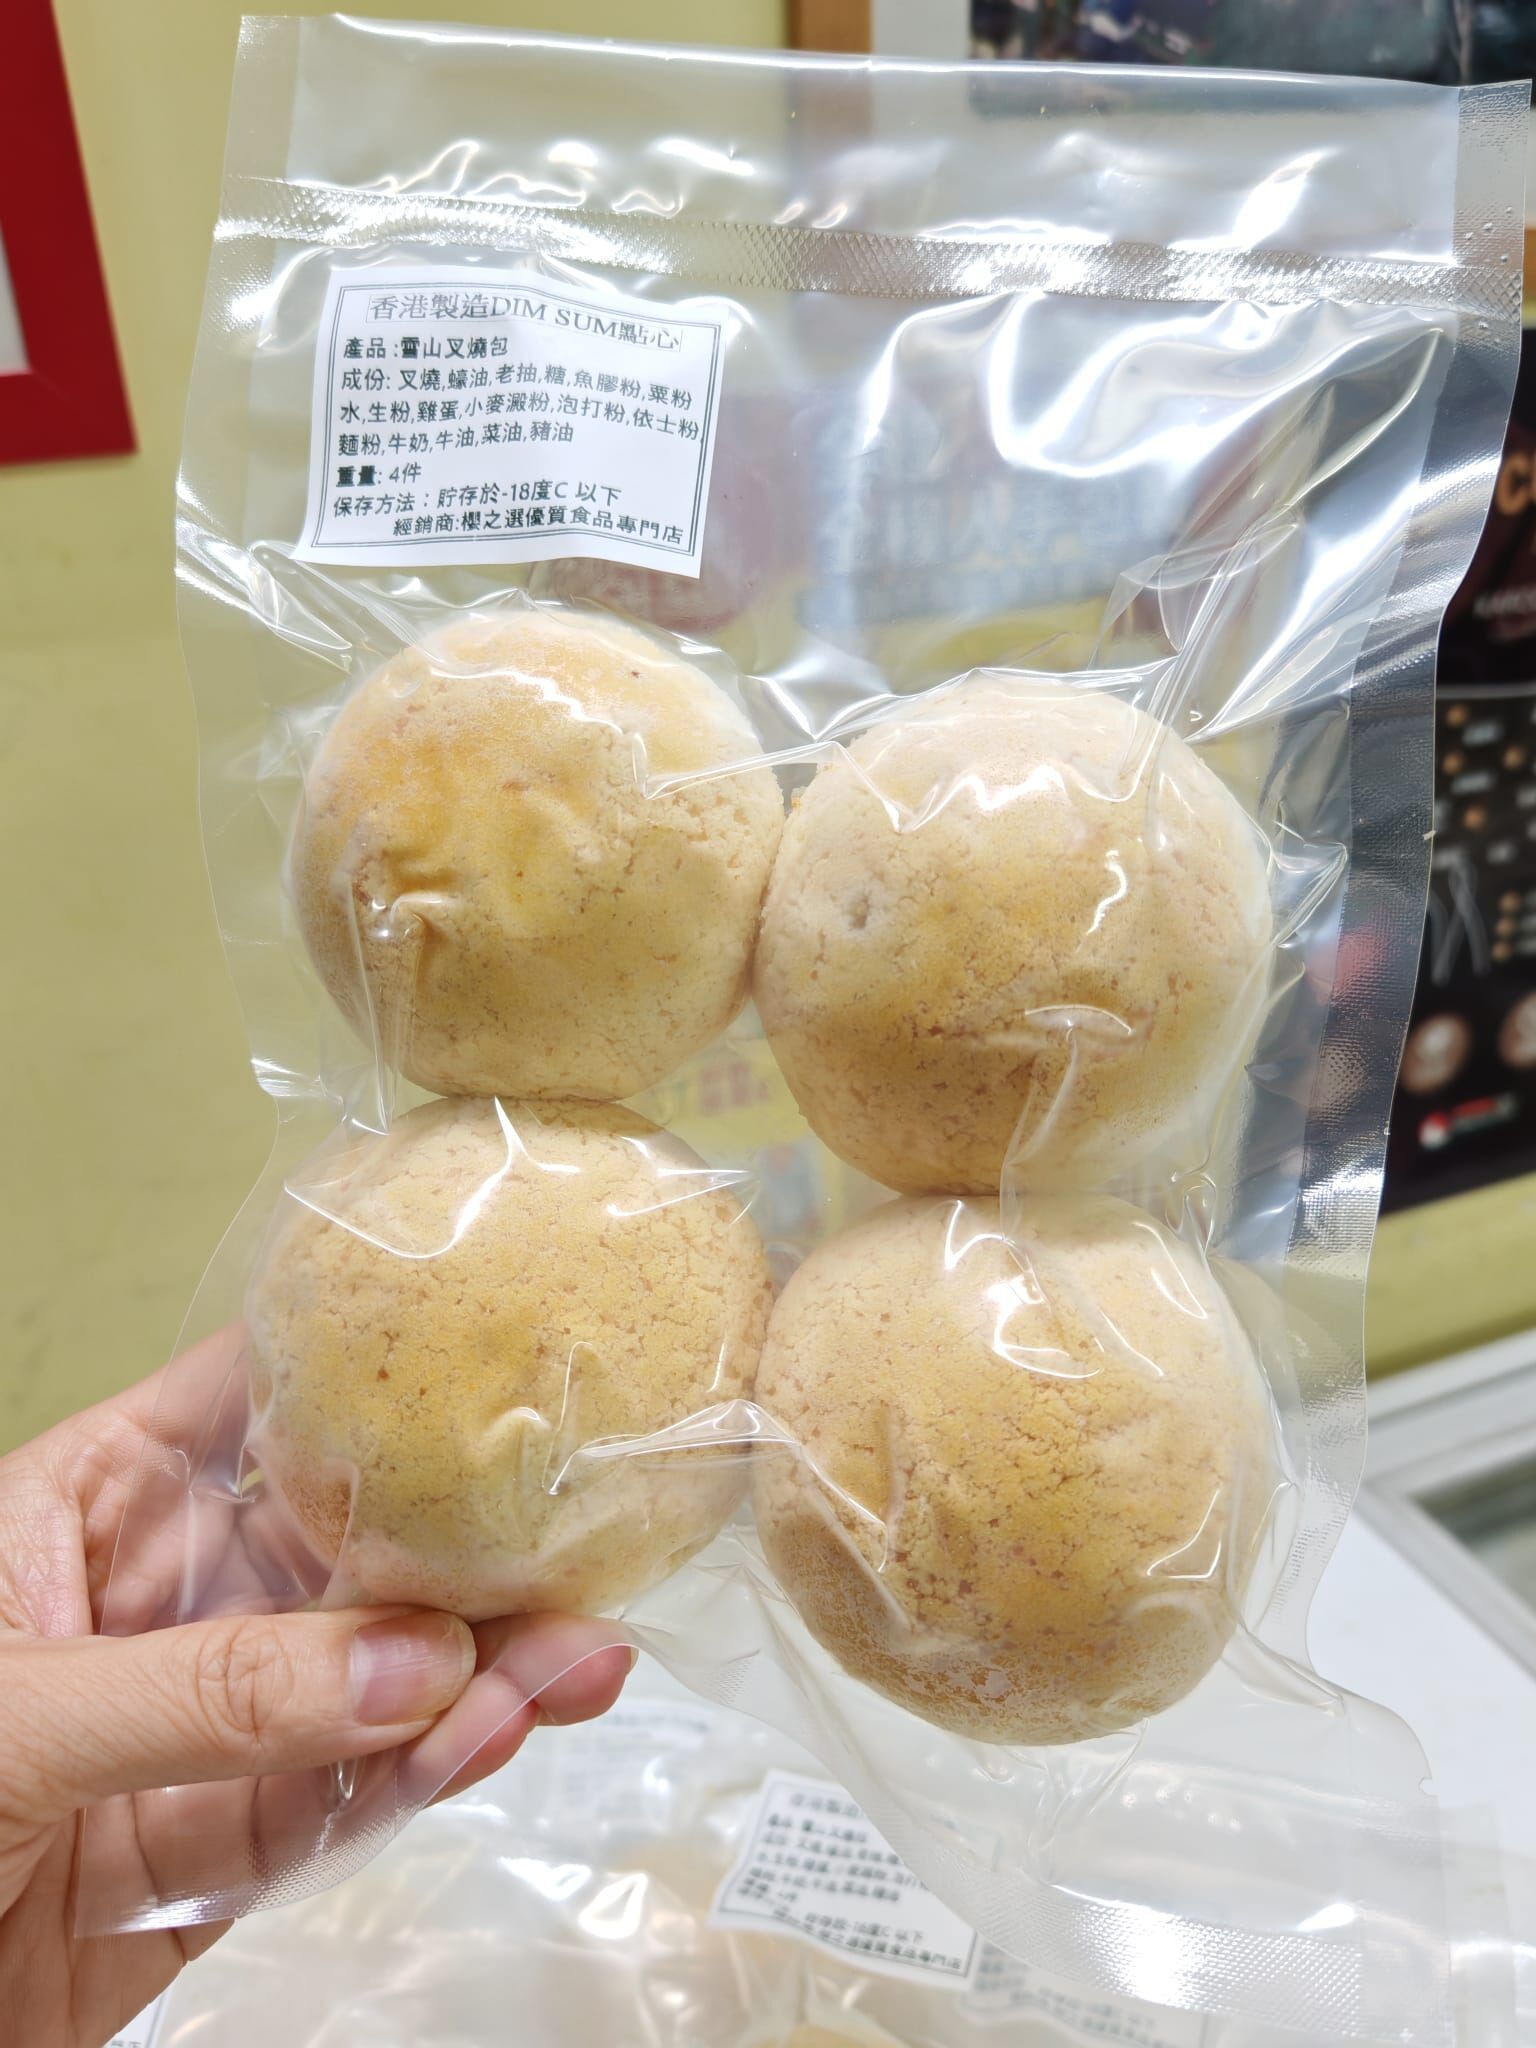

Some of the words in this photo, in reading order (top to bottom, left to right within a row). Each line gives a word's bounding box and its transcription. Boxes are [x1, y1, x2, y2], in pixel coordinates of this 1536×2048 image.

[370, 292, 546, 322] 香港製造DIM
[555, 309, 679, 349] SUM點心
[342, 337, 387, 359] 產品
[388, 460, 423, 484] 4件
[574, 481, 622, 504] 以下
